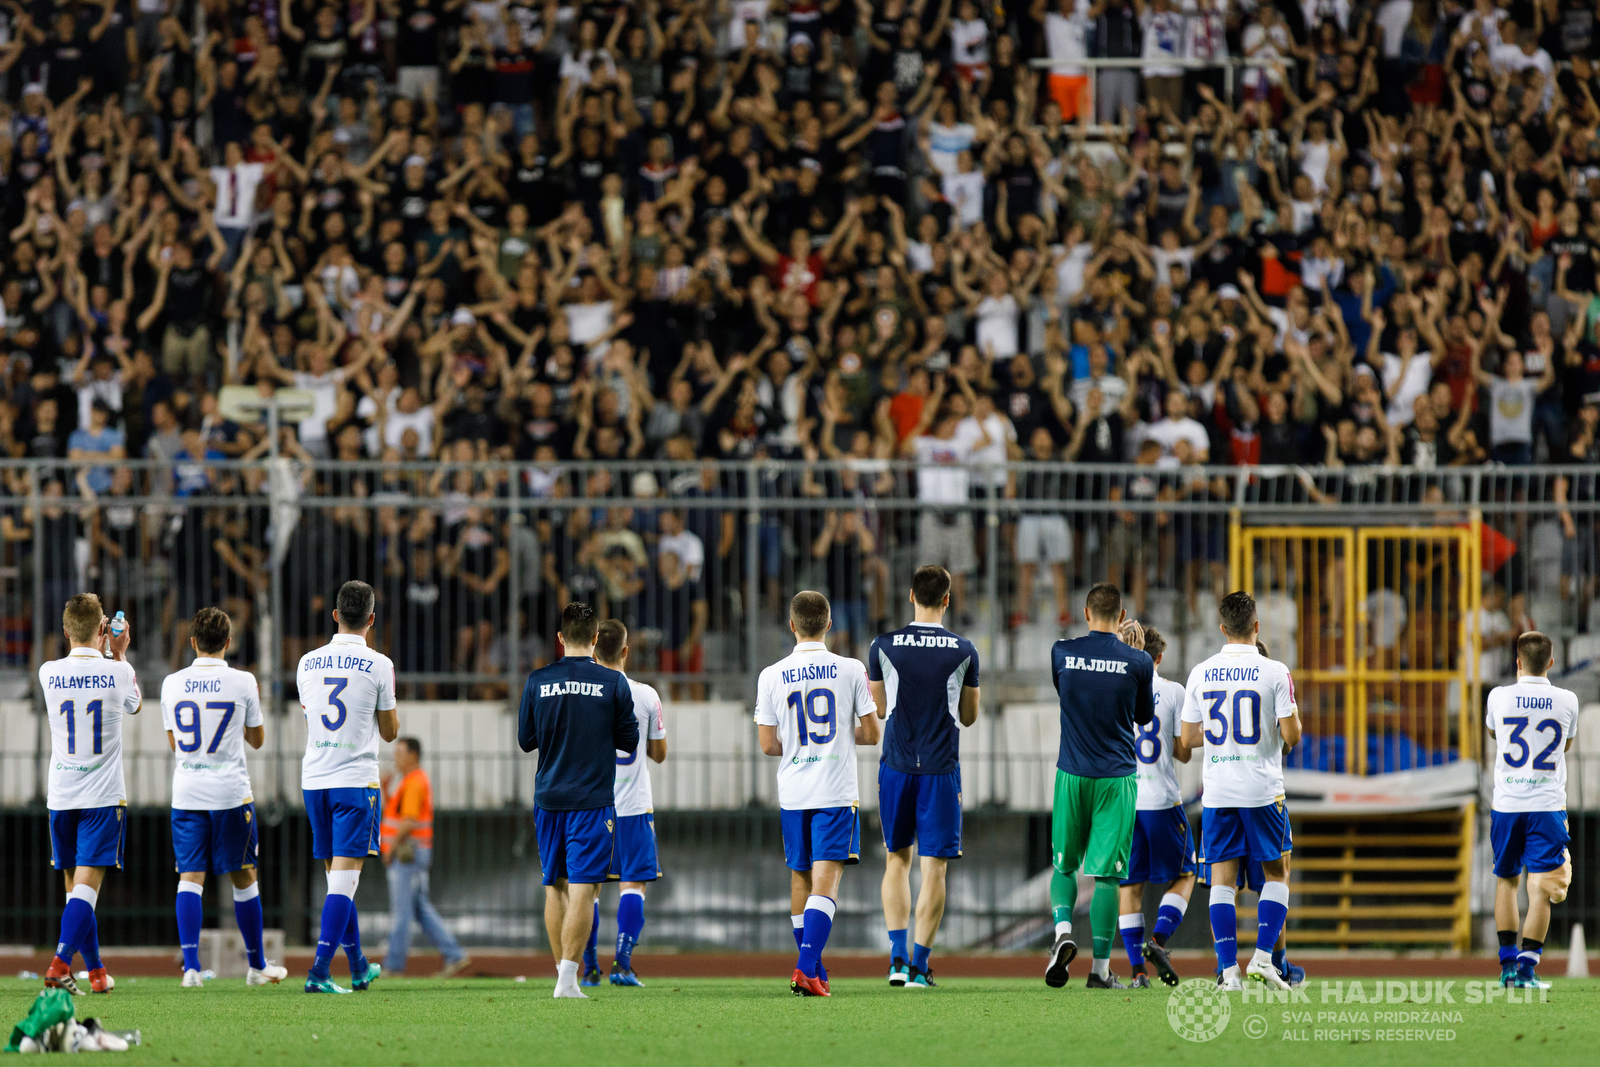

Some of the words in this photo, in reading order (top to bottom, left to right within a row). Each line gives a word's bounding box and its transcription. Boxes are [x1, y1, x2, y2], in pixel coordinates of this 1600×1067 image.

[892, 634, 959, 649] HAJDUK
[303, 655, 333, 672] BORJA
[337, 654, 374, 674] LÓPEZ
[782, 663, 838, 685] NEJAŠMIĆ
[1065, 656, 1128, 674] HAJDUK
[1204, 666, 1259, 682] KREKOVIĆ
[48, 675, 116, 690] PALAVERSA
[184, 676, 221, 693] ŠPIKIĆ
[540, 681, 604, 698] HAJDUK
[320, 676, 349, 732] 3
[1515, 696, 1553, 710] TUDOR
[59, 699, 103, 755] 11
[174, 700, 236, 754] 97
[786, 687, 838, 747] 19
[1202, 689, 1262, 745] 30
[1502, 717, 1563, 771] 32
